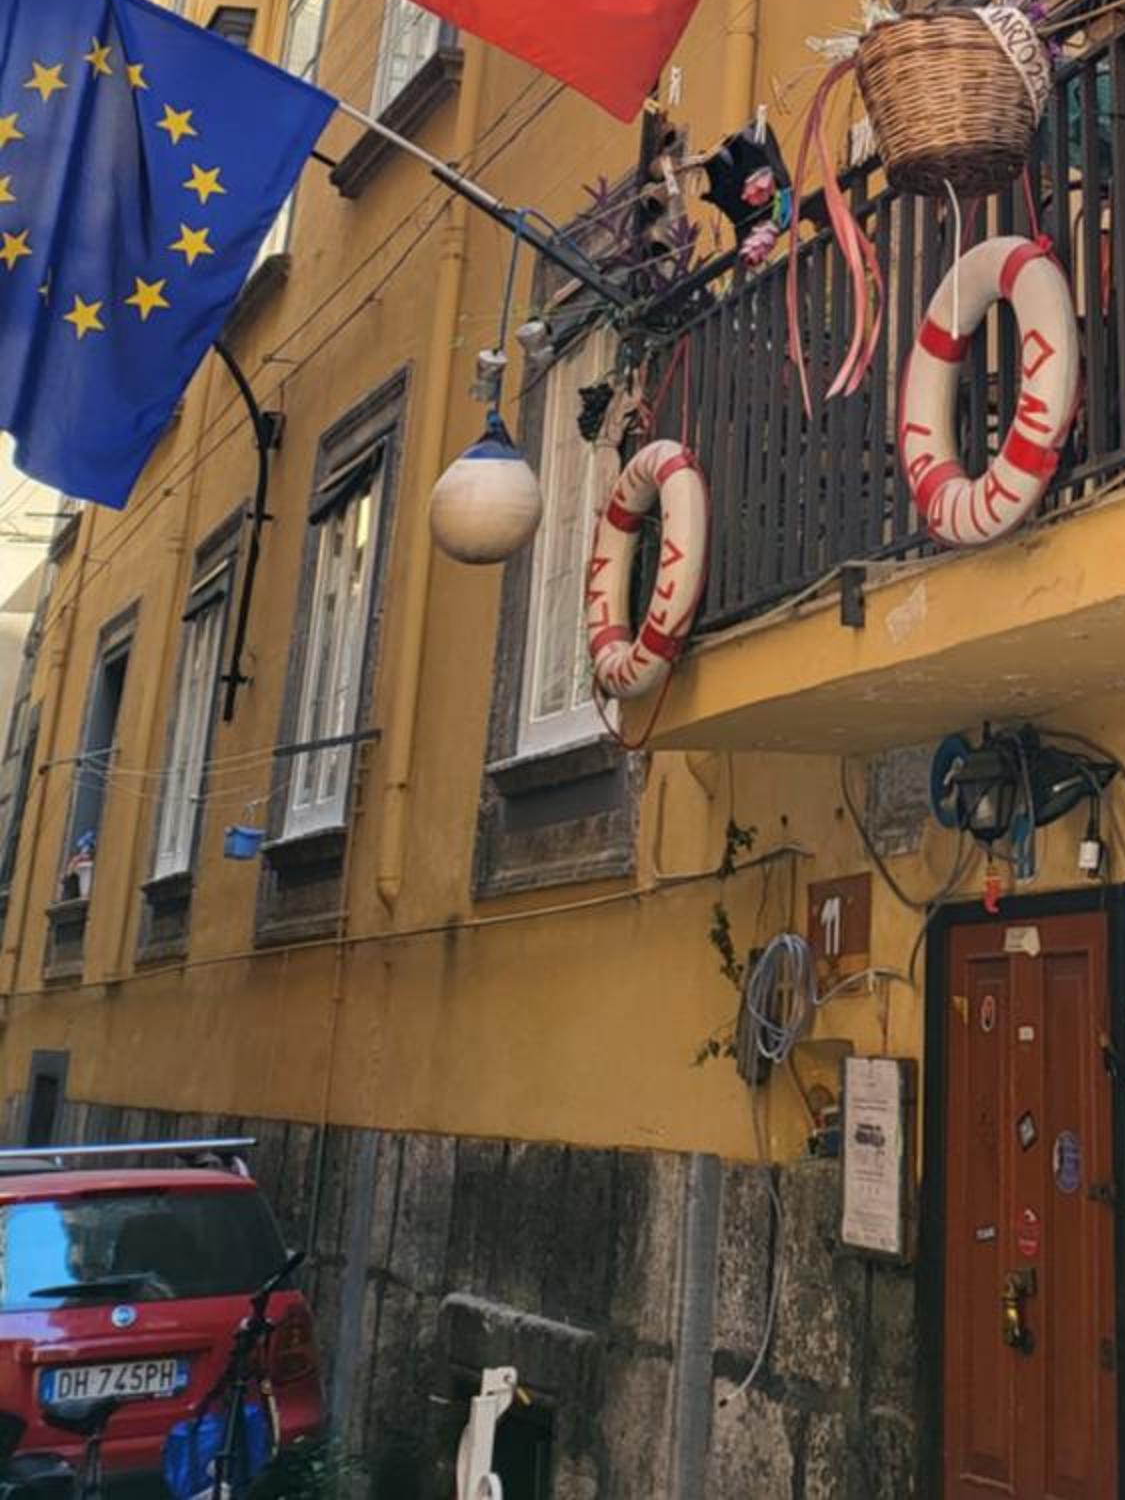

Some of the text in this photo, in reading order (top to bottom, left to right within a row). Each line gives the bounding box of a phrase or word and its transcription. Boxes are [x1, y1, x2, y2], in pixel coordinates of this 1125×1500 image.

[990, 8, 1037, 63] ARZO
[820, 897, 840, 955] 11
[59, 1371, 90, 1398] DH
